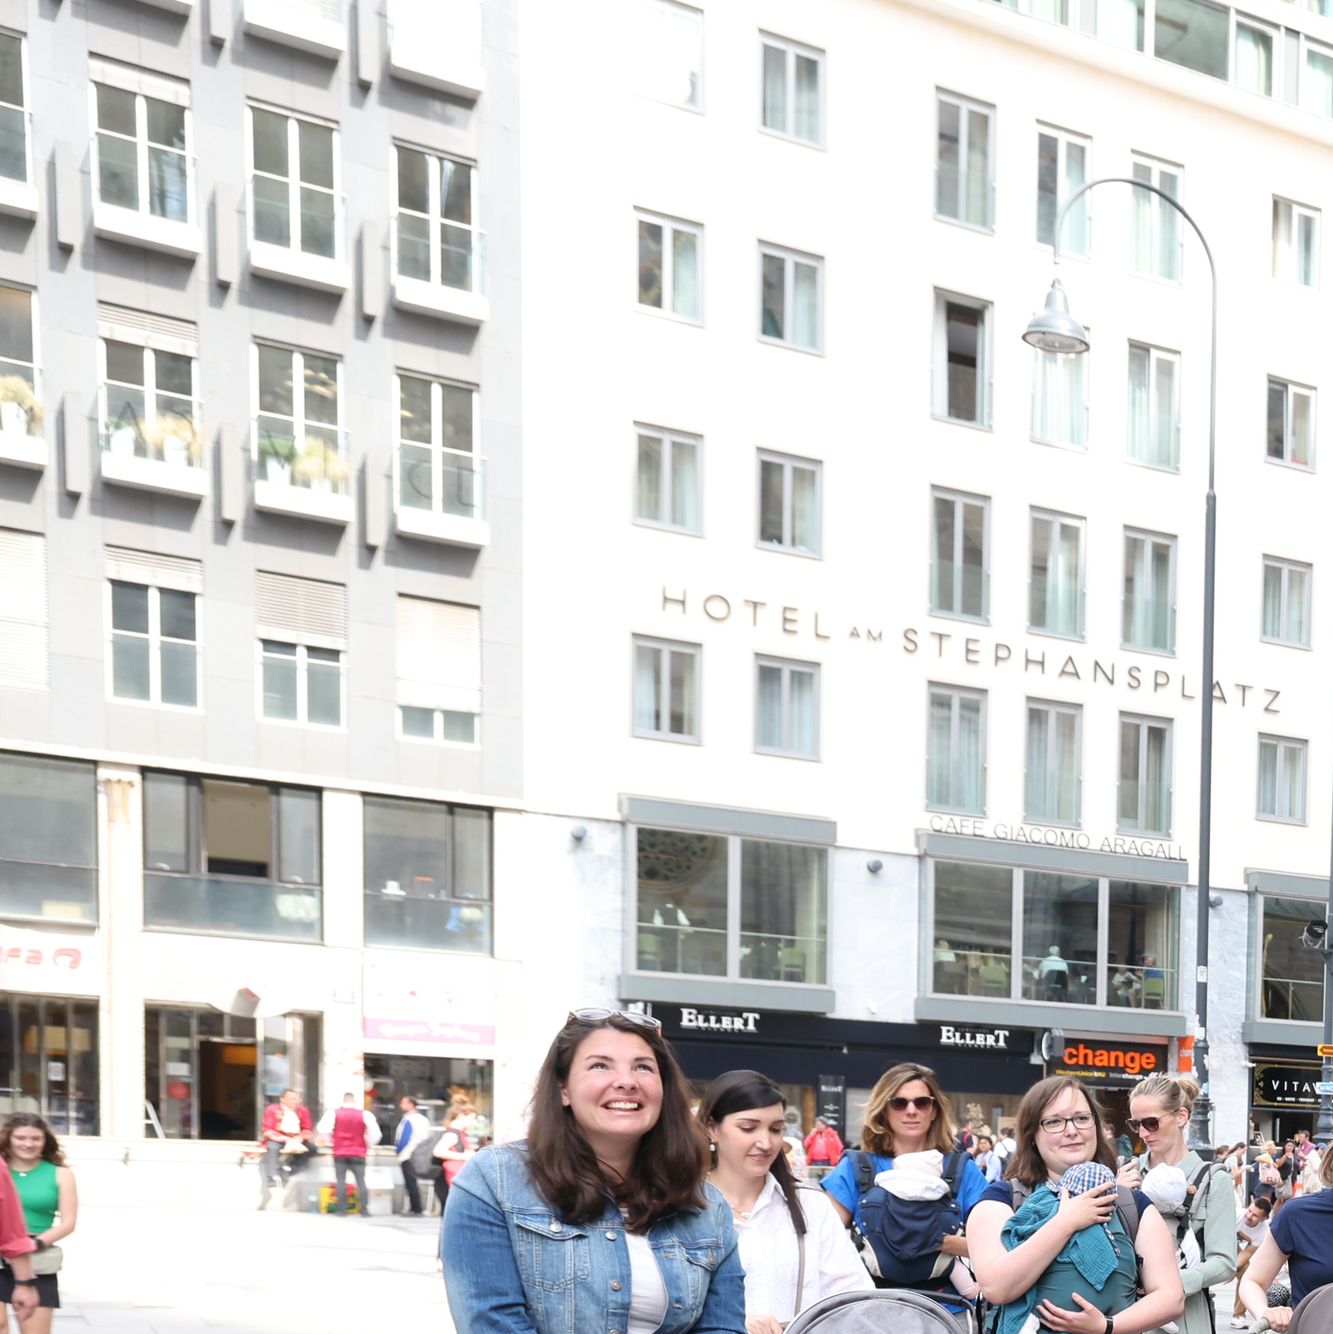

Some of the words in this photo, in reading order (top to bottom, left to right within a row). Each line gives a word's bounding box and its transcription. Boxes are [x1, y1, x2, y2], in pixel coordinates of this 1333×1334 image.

[662, 585, 831, 641] HOTEL
[849, 626, 883, 643] AM
[902, 627, 1282, 714] STEPHANSPLATZ
[993, 822, 1091, 850] GIACOMO
[1099, 836, 1188, 861] ARAGALL
[1063, 1043, 1157, 1074] change
